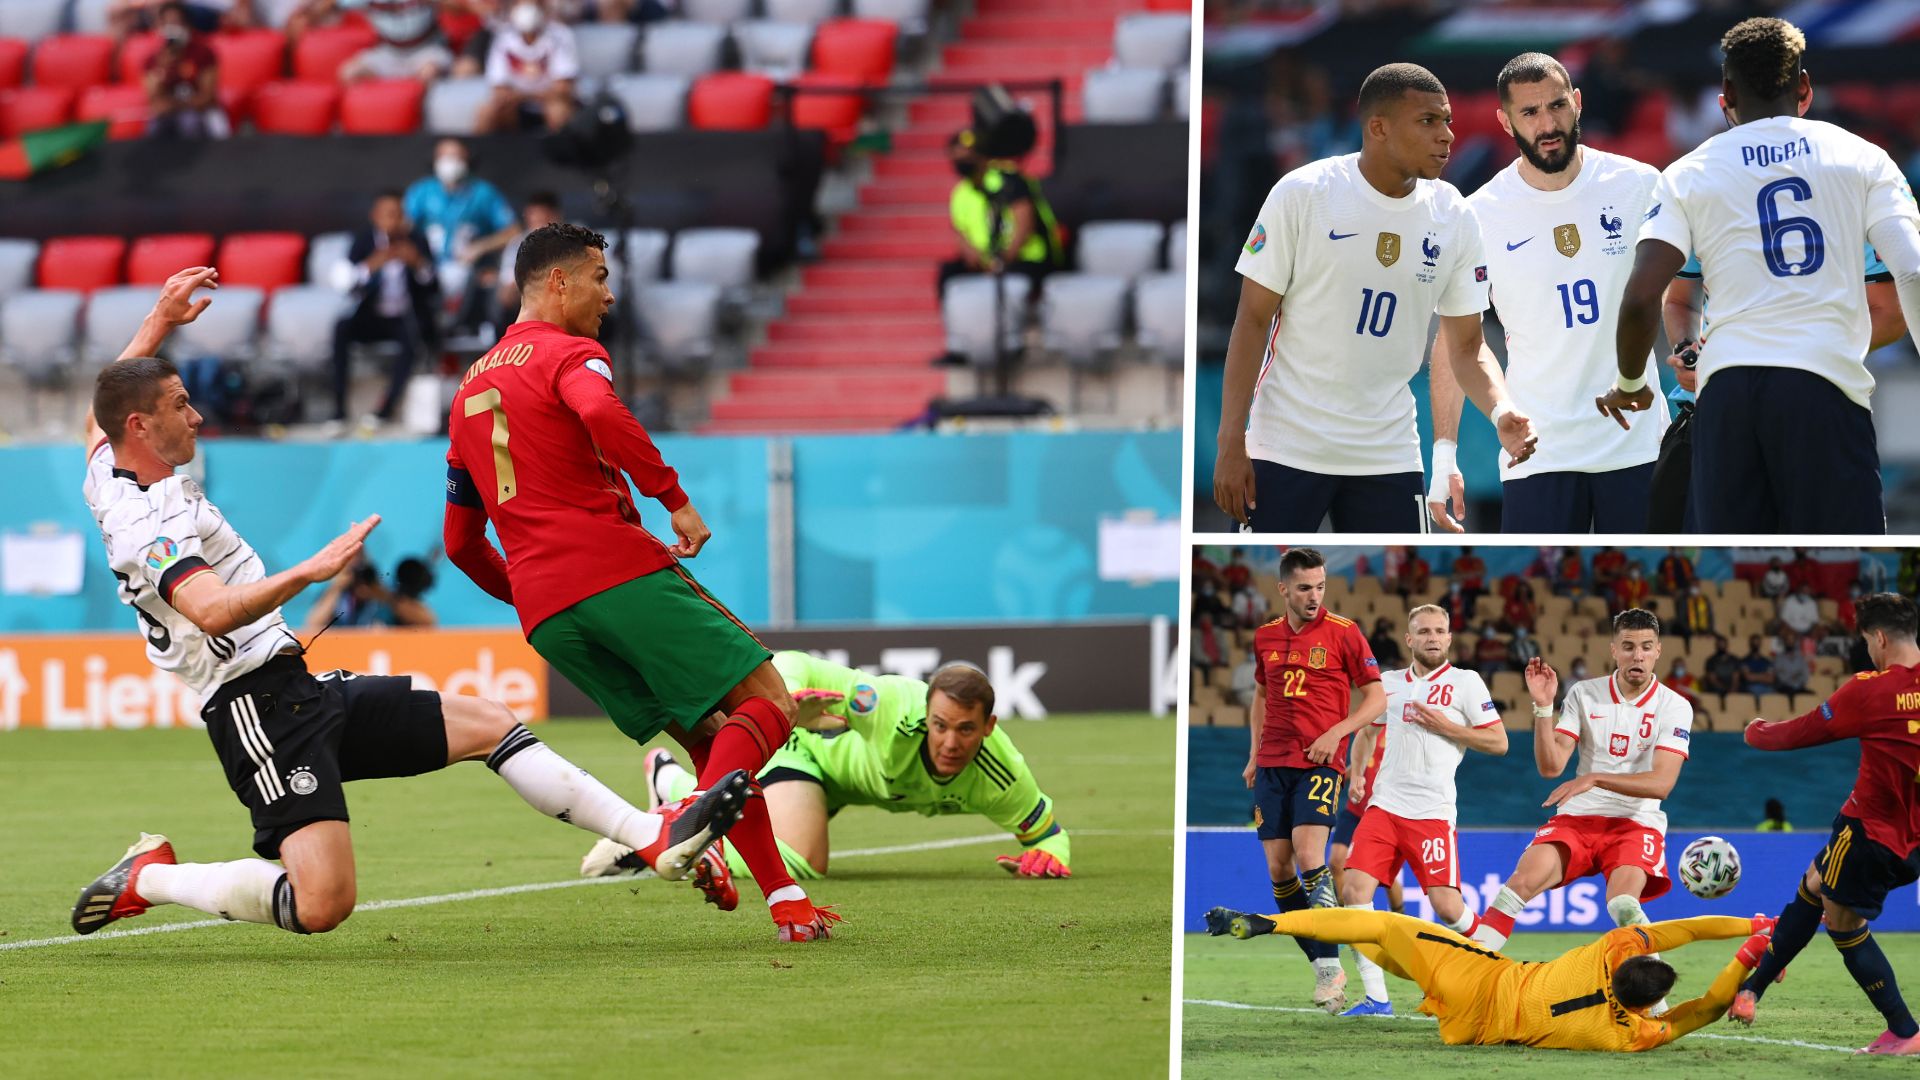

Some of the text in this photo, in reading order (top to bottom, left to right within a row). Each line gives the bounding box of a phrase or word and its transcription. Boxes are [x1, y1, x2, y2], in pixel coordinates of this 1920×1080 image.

[1741, 136, 1811, 168] POGBA
[1756, 176, 1825, 278] 6
[1356, 288, 1397, 338] 10
[1557, 278, 1600, 328] 19
[464, 387, 517, 505] 7
[1283, 669, 1307, 697] 22
[1426, 684, 1454, 707] 26
[1639, 713, 1655, 739] 5
[1308, 775, 1333, 804] 22
[1421, 837, 1446, 863] 26
[1642, 833, 1655, 856] 5
[1550, 988, 1609, 1018] 1
